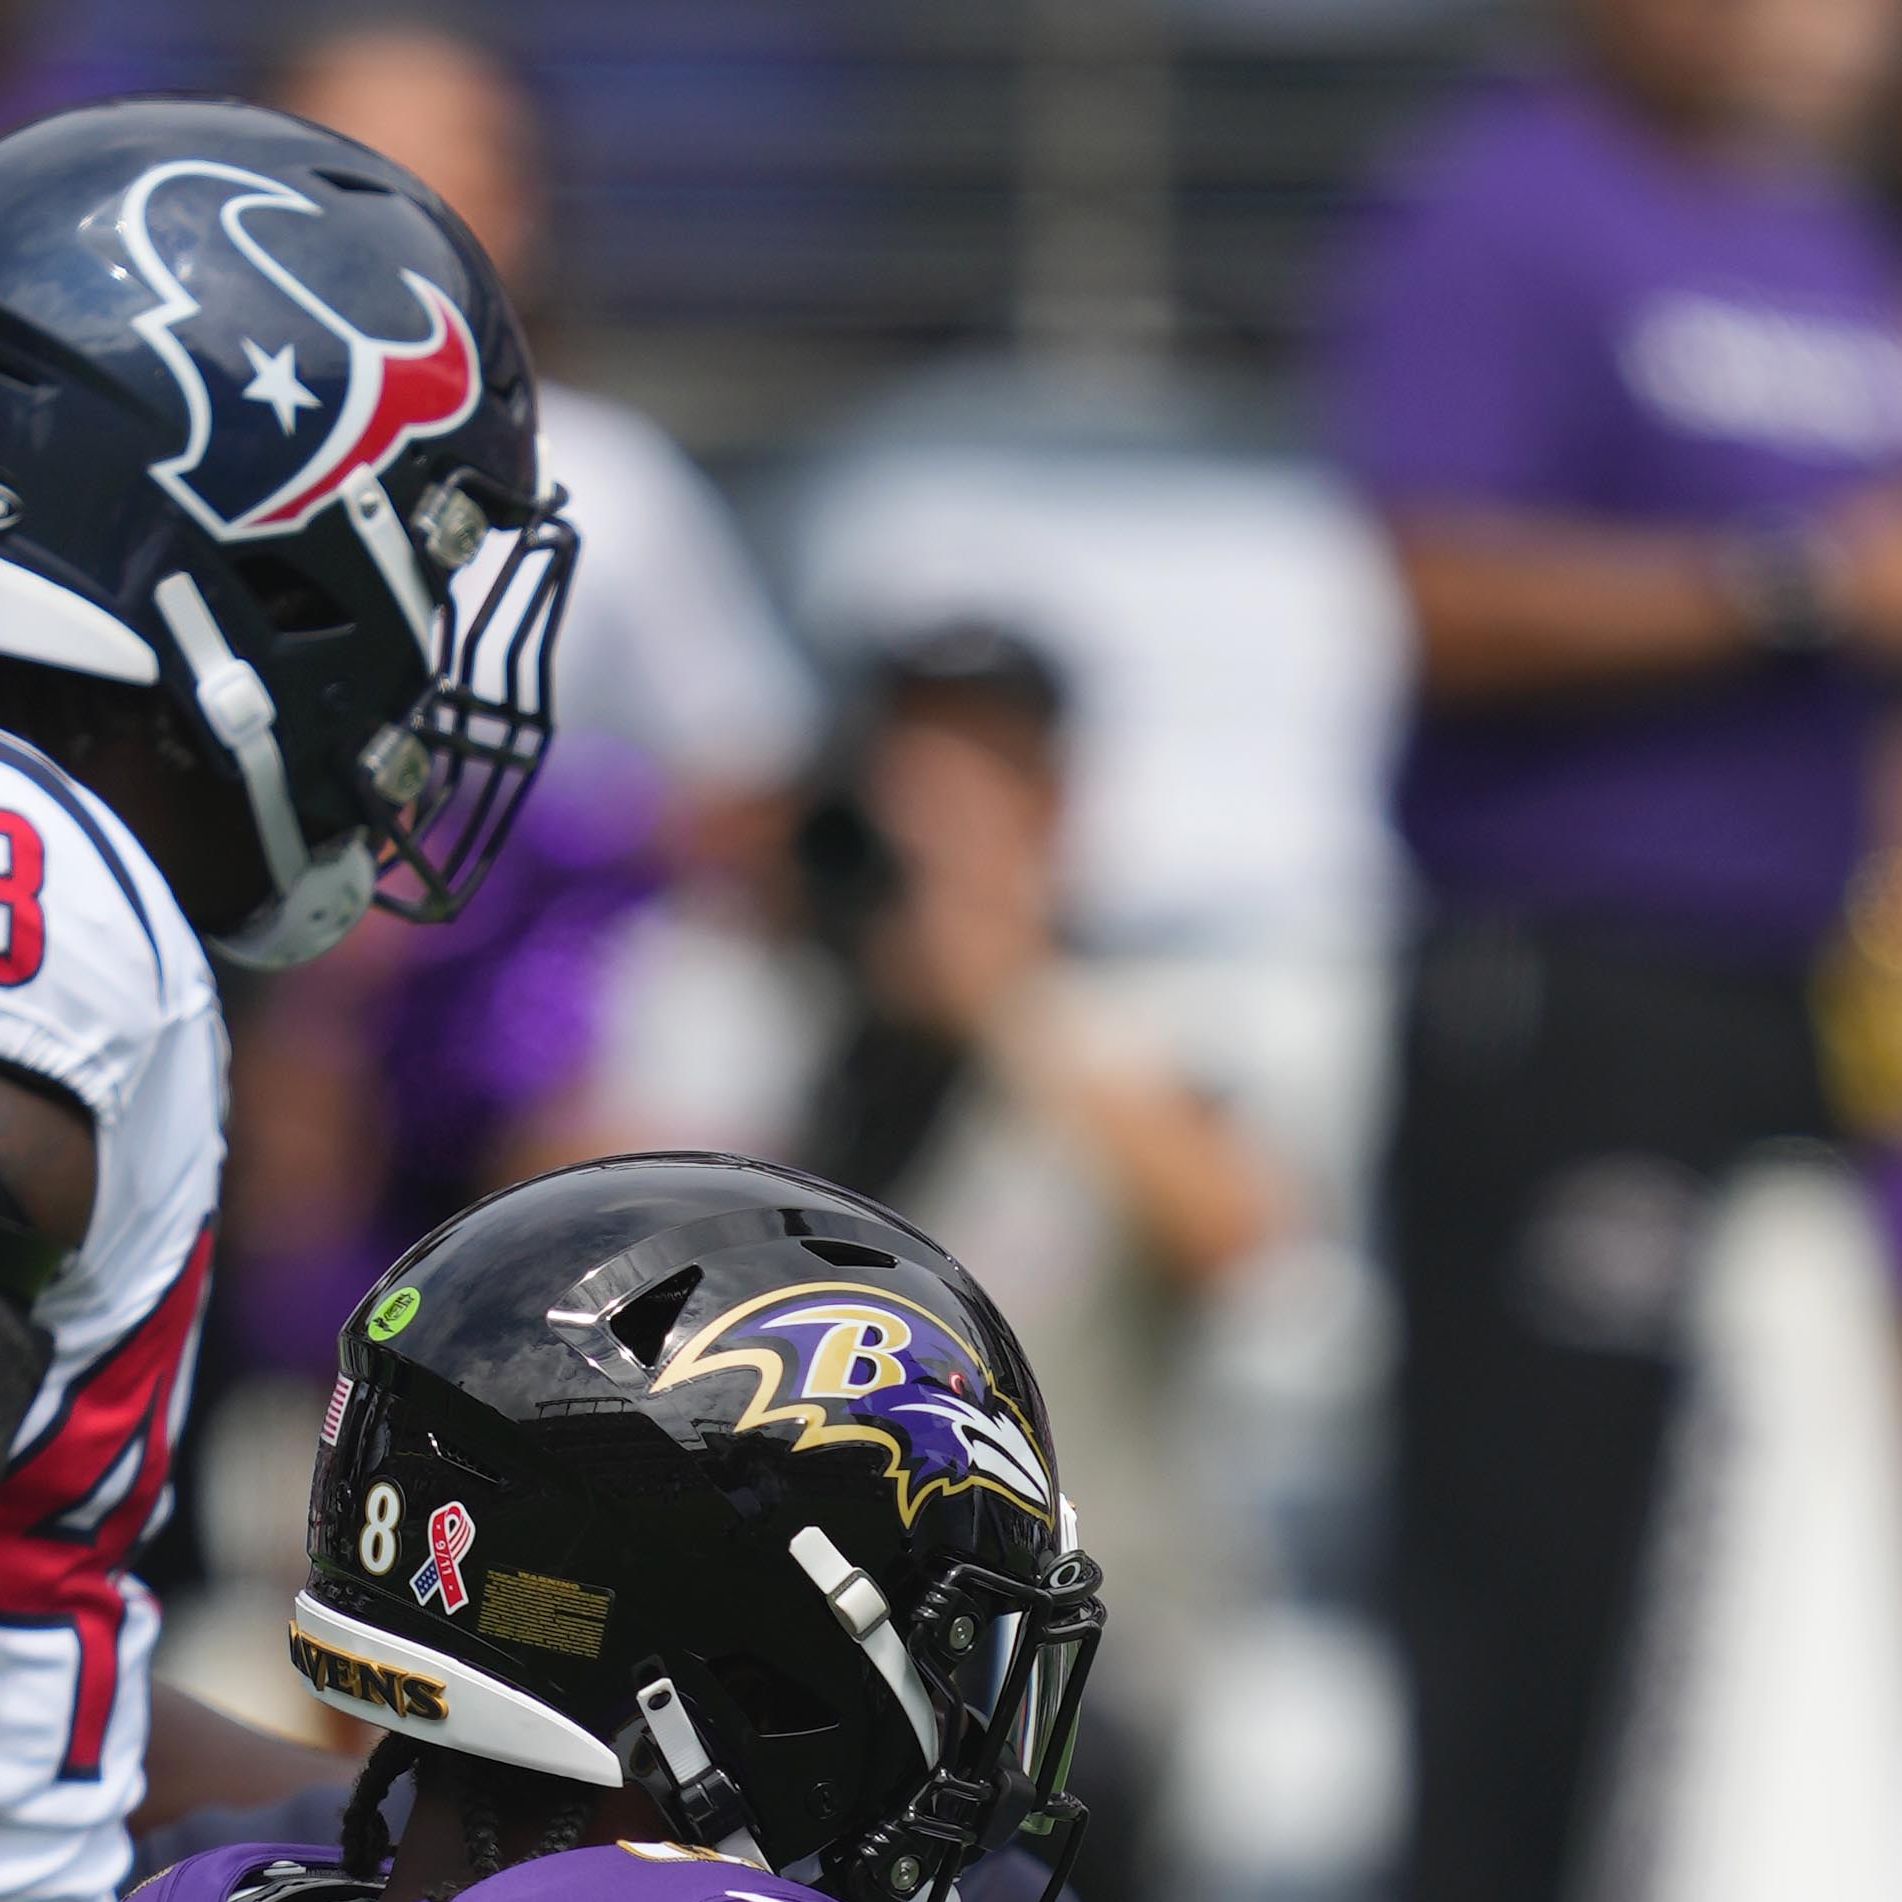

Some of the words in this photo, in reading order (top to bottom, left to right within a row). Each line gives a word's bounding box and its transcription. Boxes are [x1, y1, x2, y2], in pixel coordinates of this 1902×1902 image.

[760, 1304, 912, 1400] B
[360, 1480, 401, 1577] 8
[435, 1540, 452, 1575] 9/11
[518, 1571, 580, 1591] WARNING
